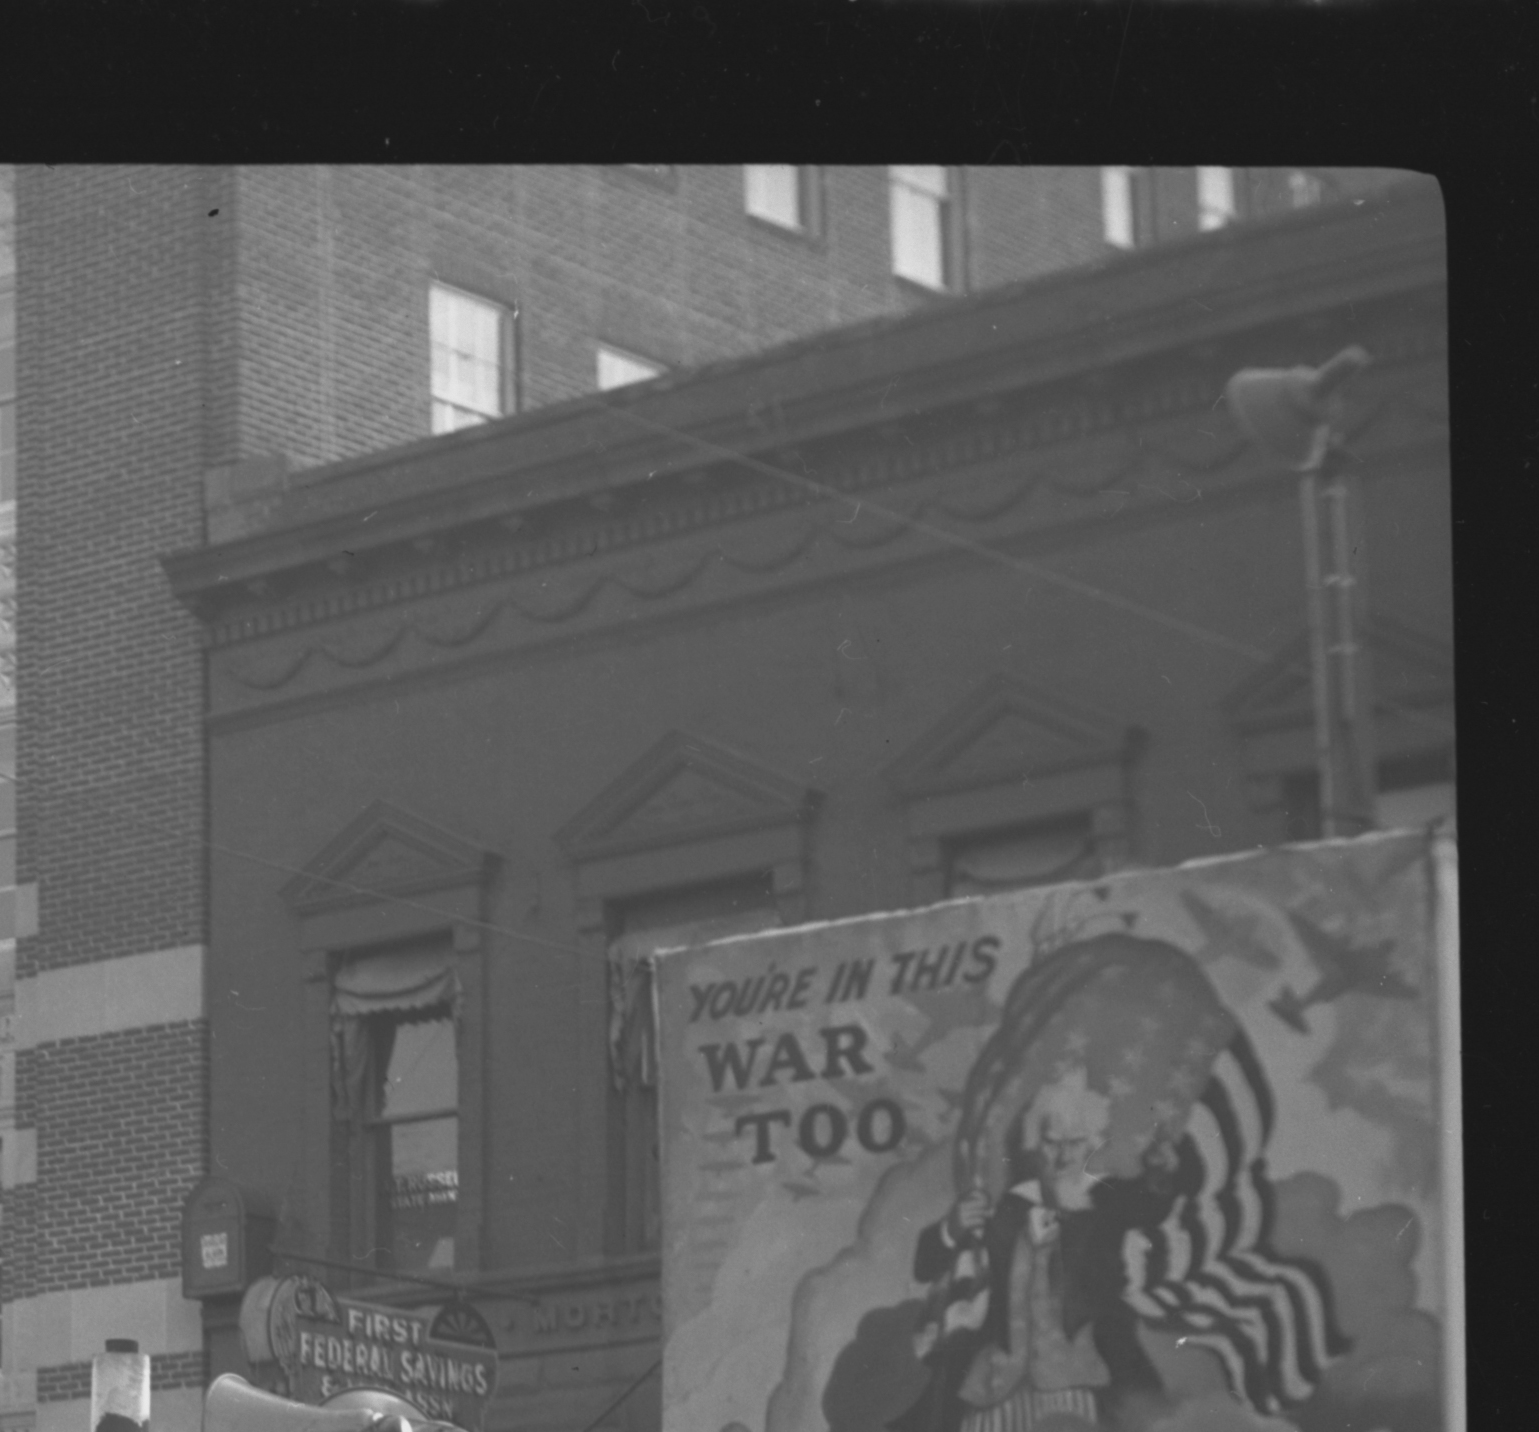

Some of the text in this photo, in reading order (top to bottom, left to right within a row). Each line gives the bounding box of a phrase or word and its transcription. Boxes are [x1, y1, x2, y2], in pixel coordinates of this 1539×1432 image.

[689, 935, 1001, 1023] YOU'RE IN THIS
[698, 1023, 874, 1093] WAR
[734, 1097, 906, 1165] TOO
[347, 1308, 423, 1346] FIRST
[299, 1331, 487, 1397] FEDERAL SAVINGS
